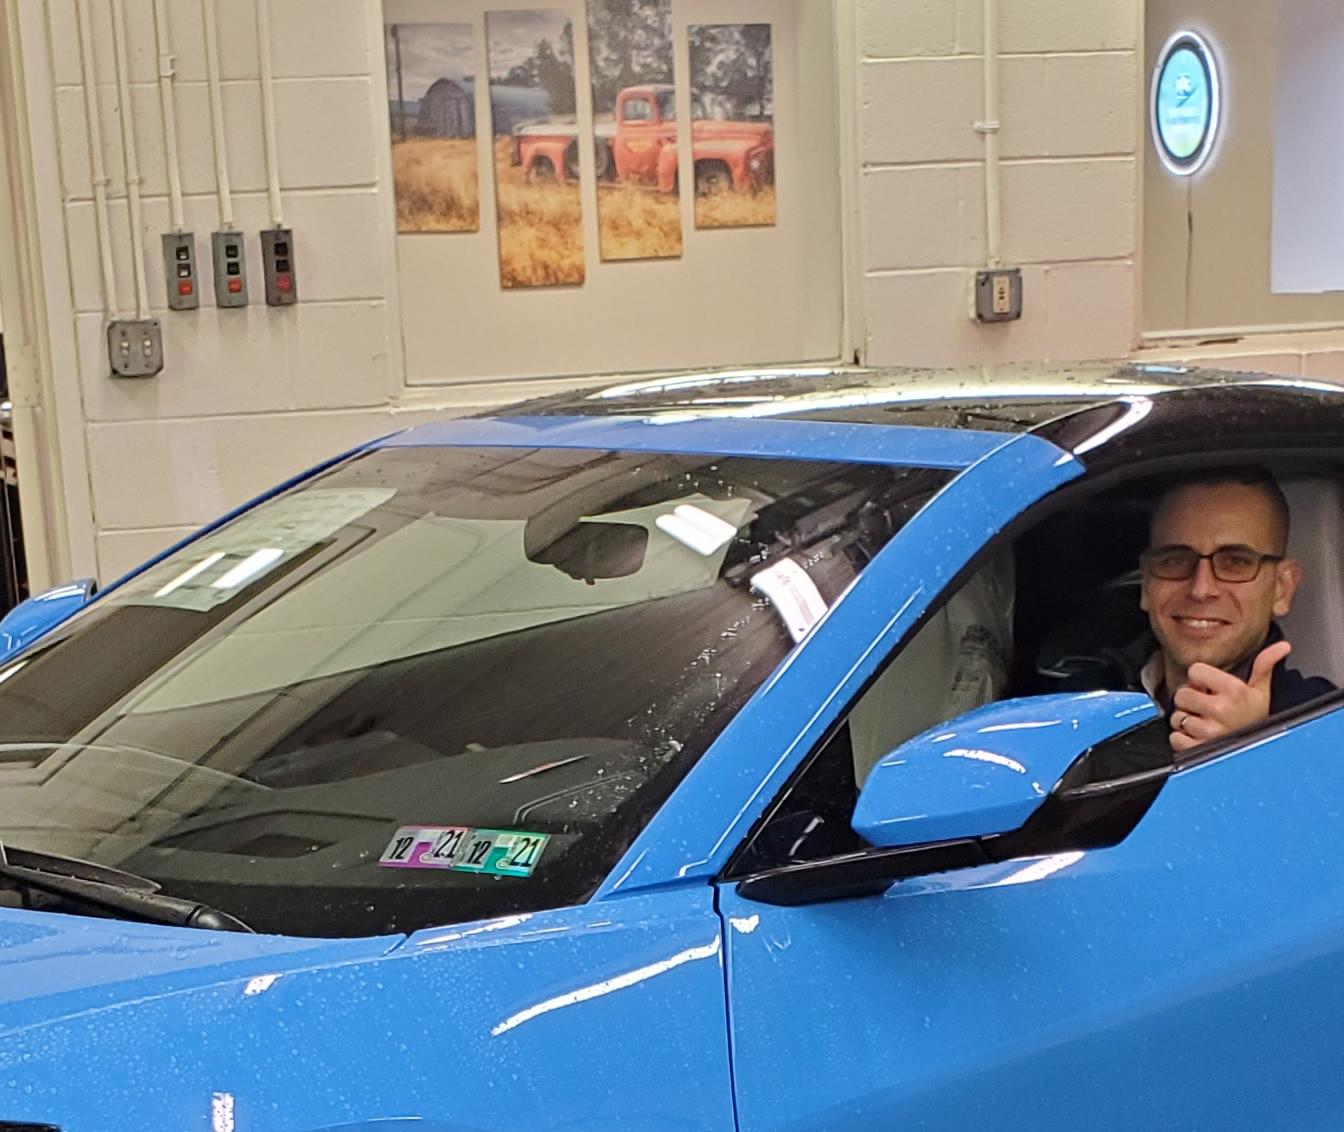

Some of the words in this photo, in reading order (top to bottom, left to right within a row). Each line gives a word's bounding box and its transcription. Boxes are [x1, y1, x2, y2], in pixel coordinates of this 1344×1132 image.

[390, 837, 413, 859] 12
[433, 830, 463, 858] 21
[468, 841, 492, 864] 12
[509, 837, 539, 866] 21
